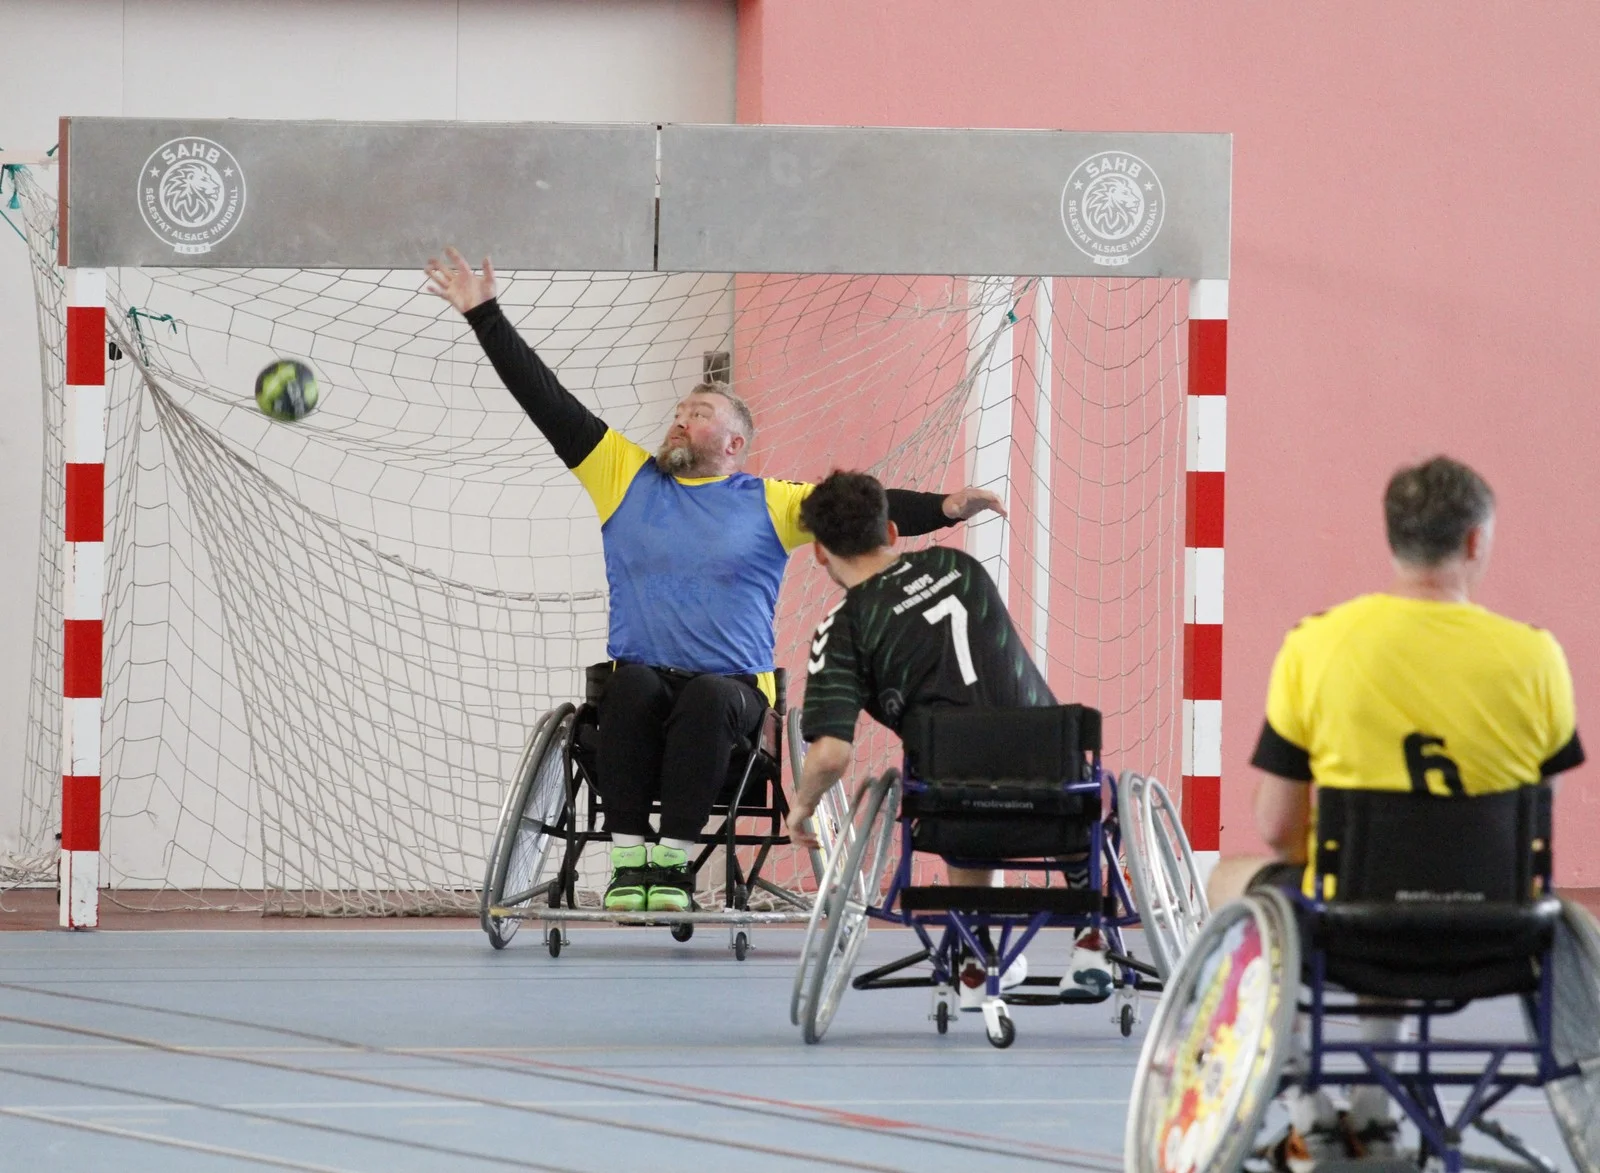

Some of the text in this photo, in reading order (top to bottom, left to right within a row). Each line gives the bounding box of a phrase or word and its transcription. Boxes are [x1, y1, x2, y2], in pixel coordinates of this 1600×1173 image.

[161, 142, 221, 165] SAHB
[1085, 157, 1142, 178] SAHB
[145, 186, 238, 241] SÉLESTAT ALSACE HANDBALL
[1068, 199, 1158, 253] SÉLESTAT ALSACE HANDBALL
[922, 594, 978, 686] 7
[1403, 732, 1467, 797] 6
